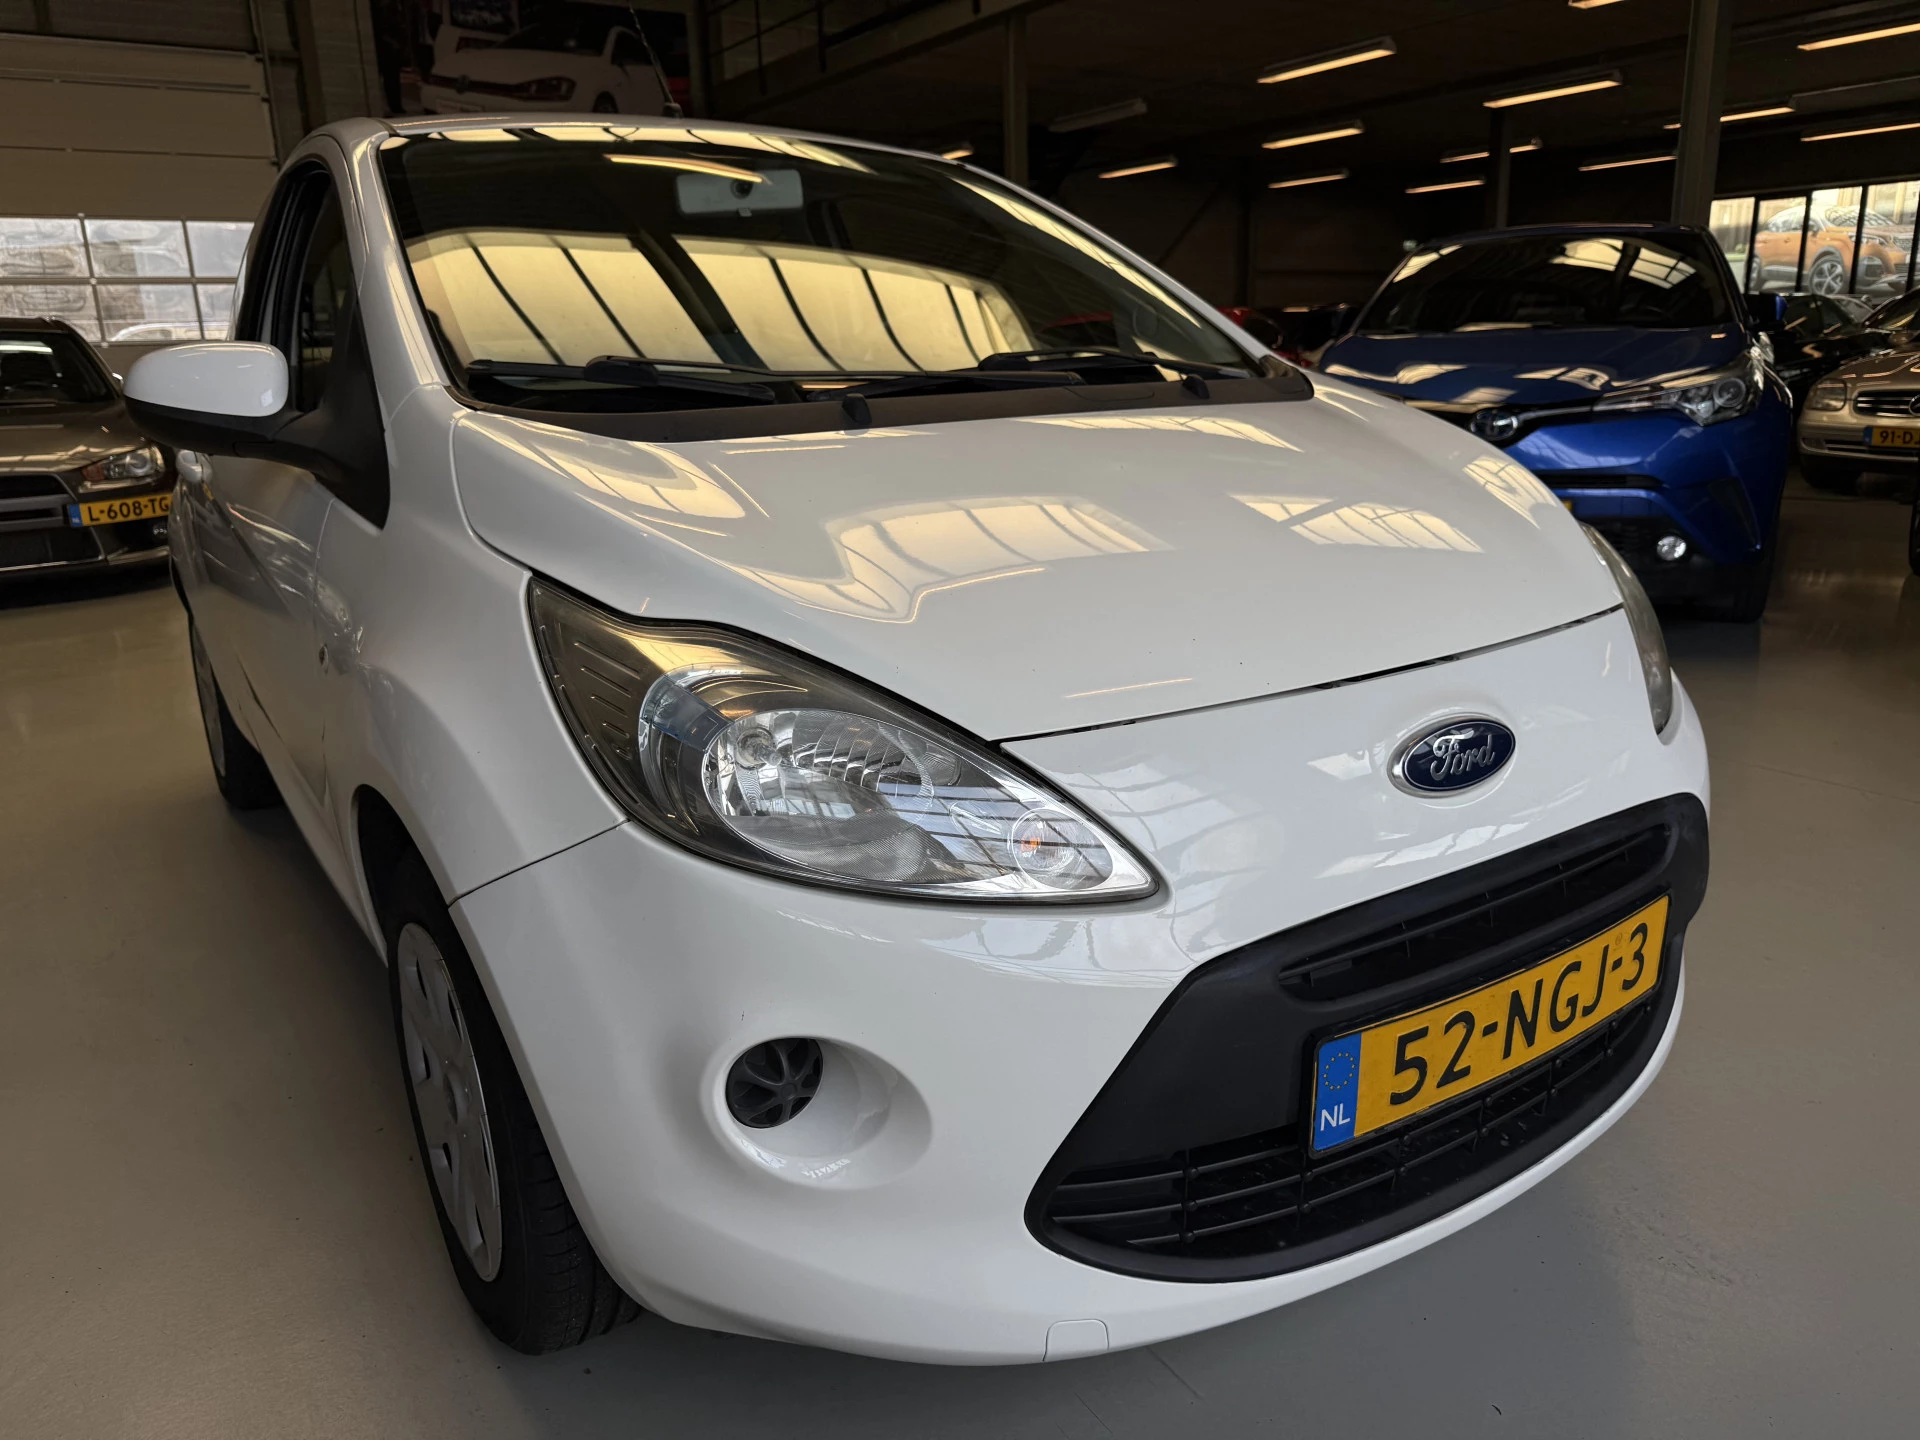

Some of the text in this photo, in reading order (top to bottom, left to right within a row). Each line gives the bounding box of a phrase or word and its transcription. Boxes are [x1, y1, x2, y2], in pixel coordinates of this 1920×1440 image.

[87, 496, 170, 522] L-608-TG
[1430, 730, 1495, 781] Ford
[1390, 922, 1648, 1106] 52-NGJ-3
[1320, 1103, 1351, 1131] NL
